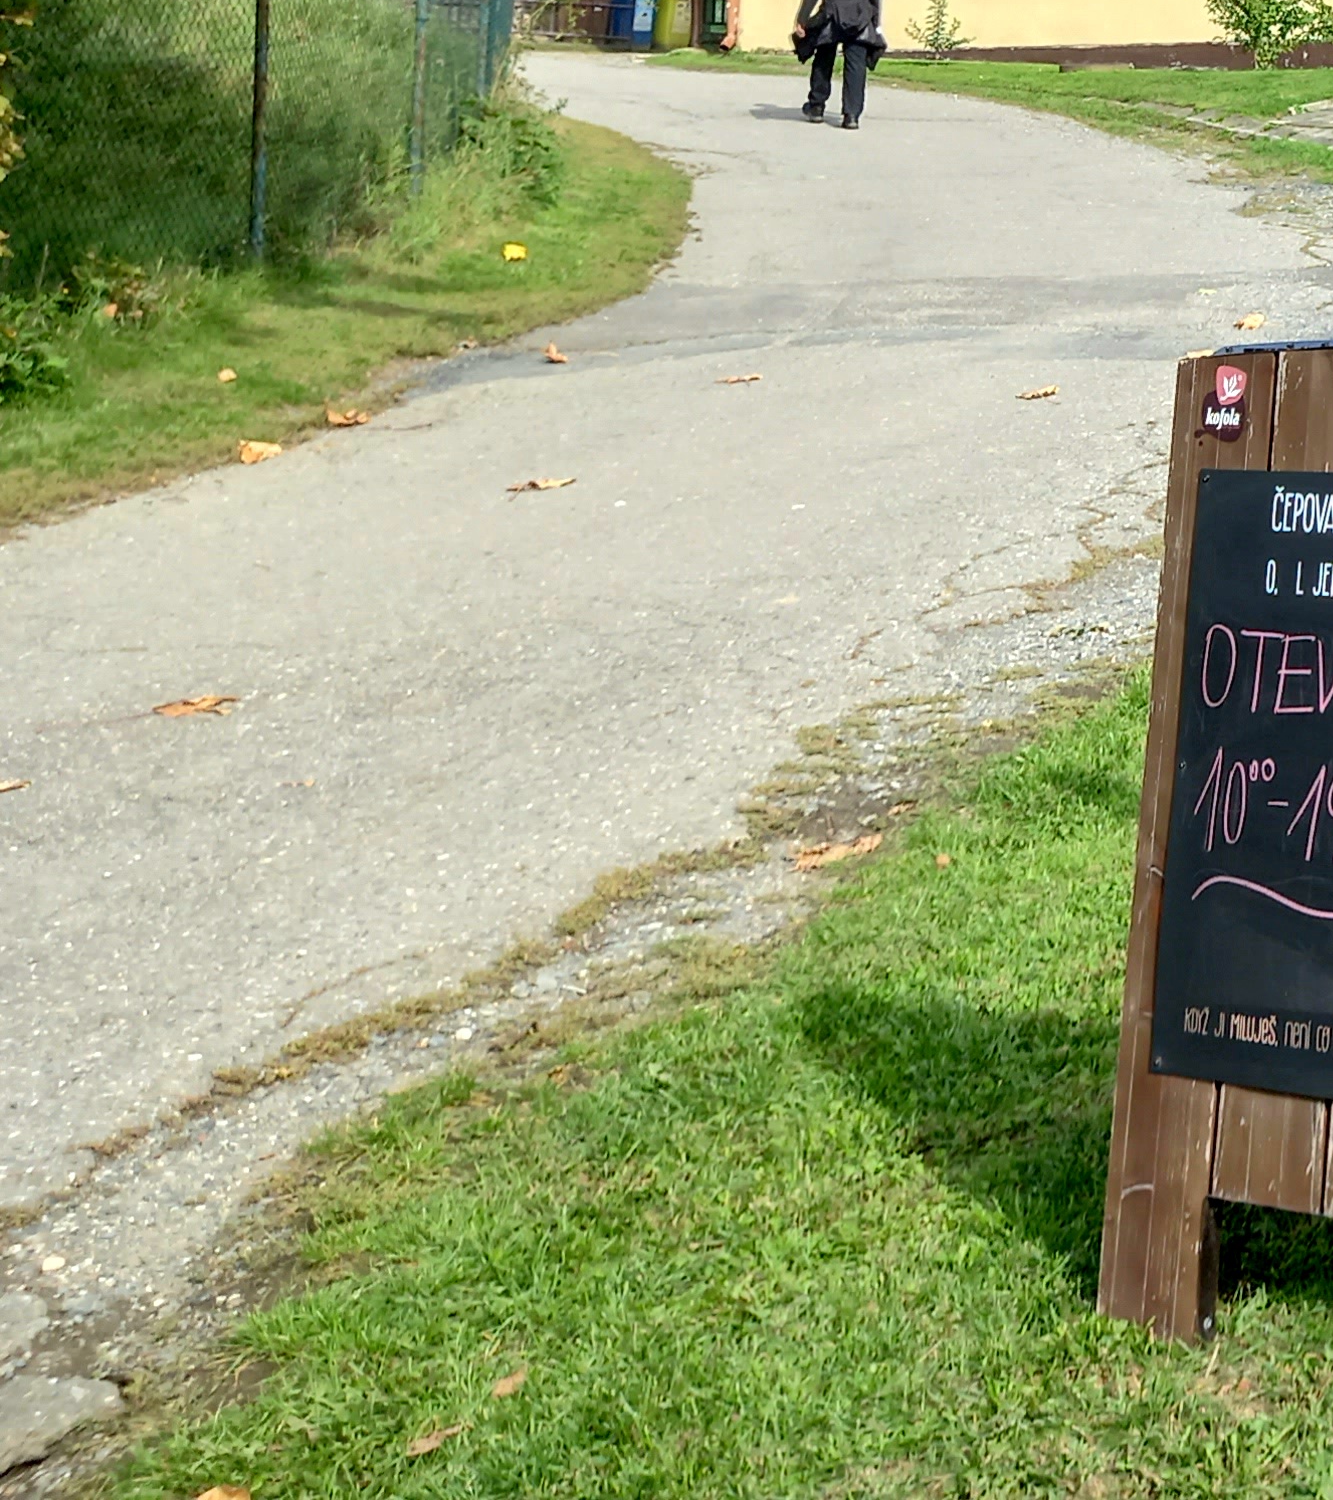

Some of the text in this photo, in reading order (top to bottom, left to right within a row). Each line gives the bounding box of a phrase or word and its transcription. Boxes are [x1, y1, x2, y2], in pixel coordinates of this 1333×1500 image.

[1205, 406, 1241, 431] kofola
[1184, 1006, 1210, 1035] KDYŽ
[1213, 1012, 1226, 1039] JI
